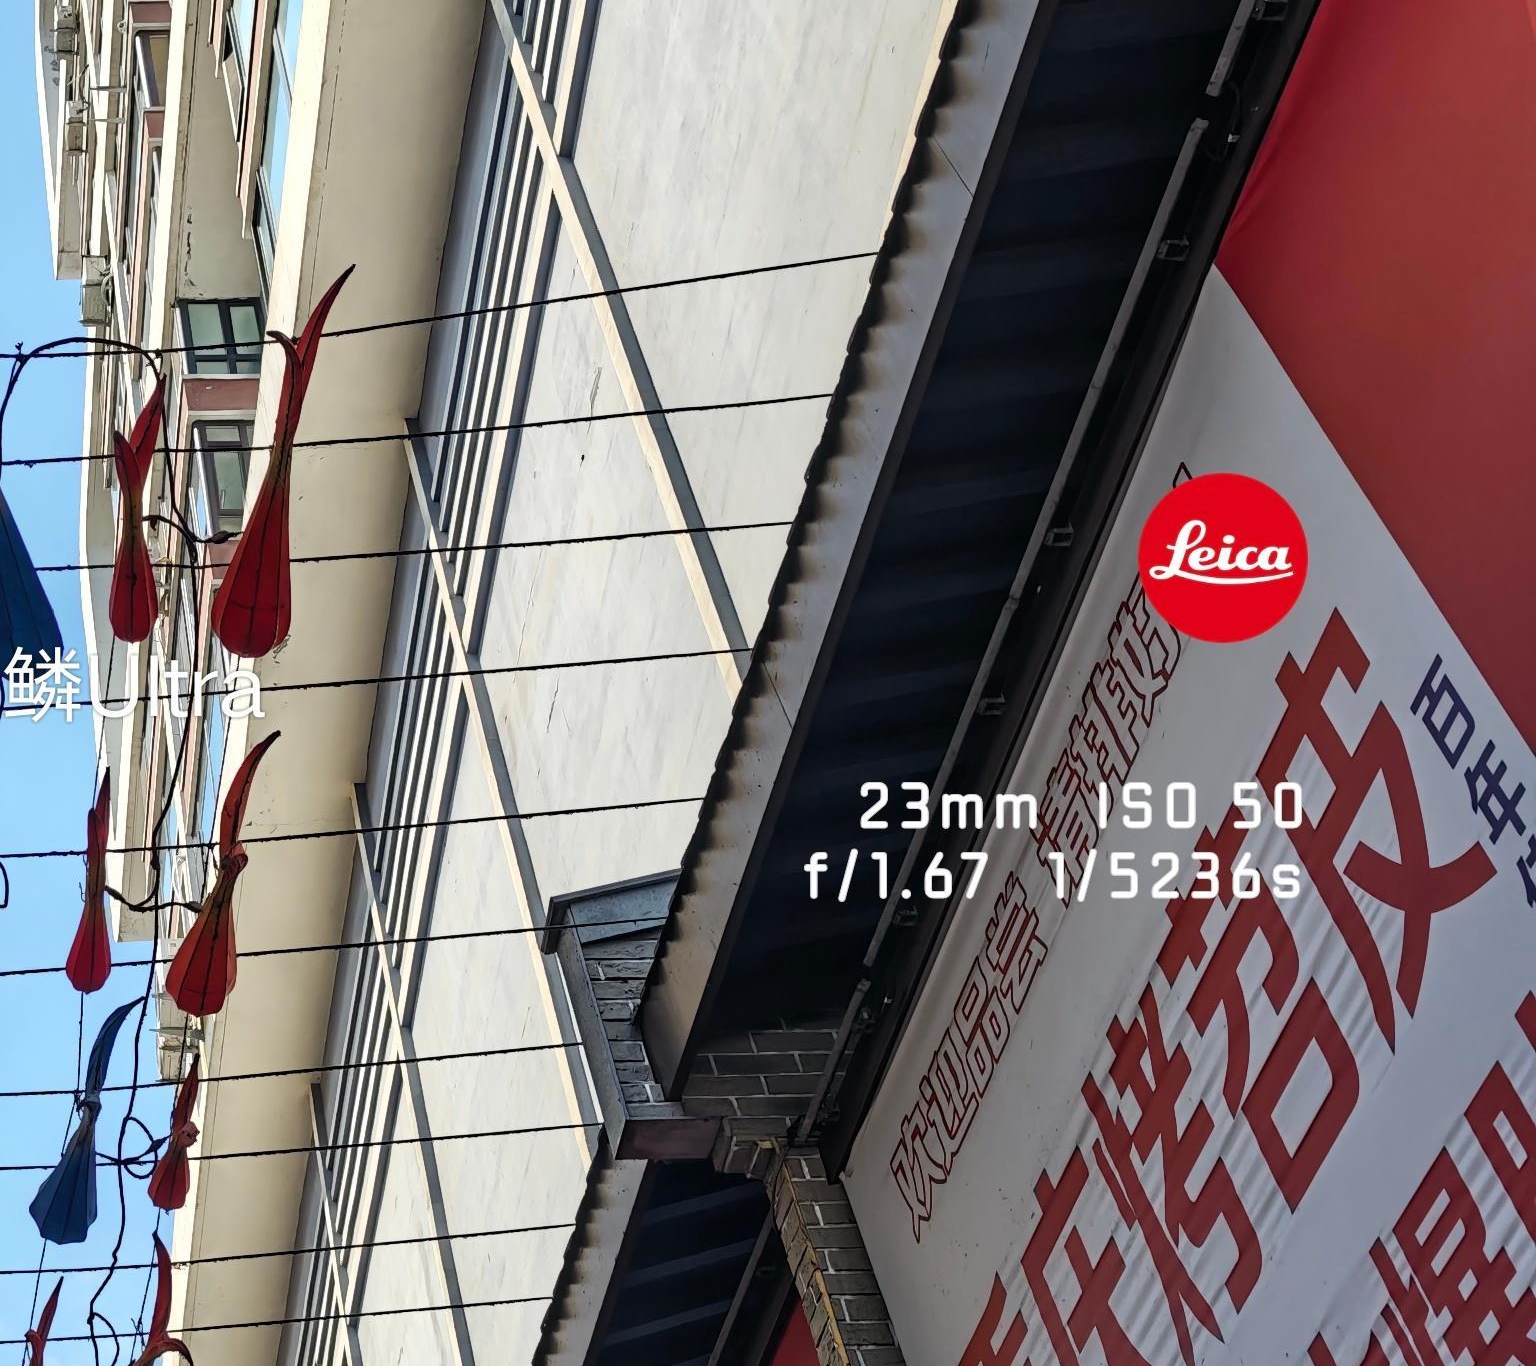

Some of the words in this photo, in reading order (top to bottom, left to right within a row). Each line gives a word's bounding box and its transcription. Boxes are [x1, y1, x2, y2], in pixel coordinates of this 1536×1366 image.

[889, 870, 1047, 1244] 欢迎品尝
[1030, 463, 1196, 909] 请排好
